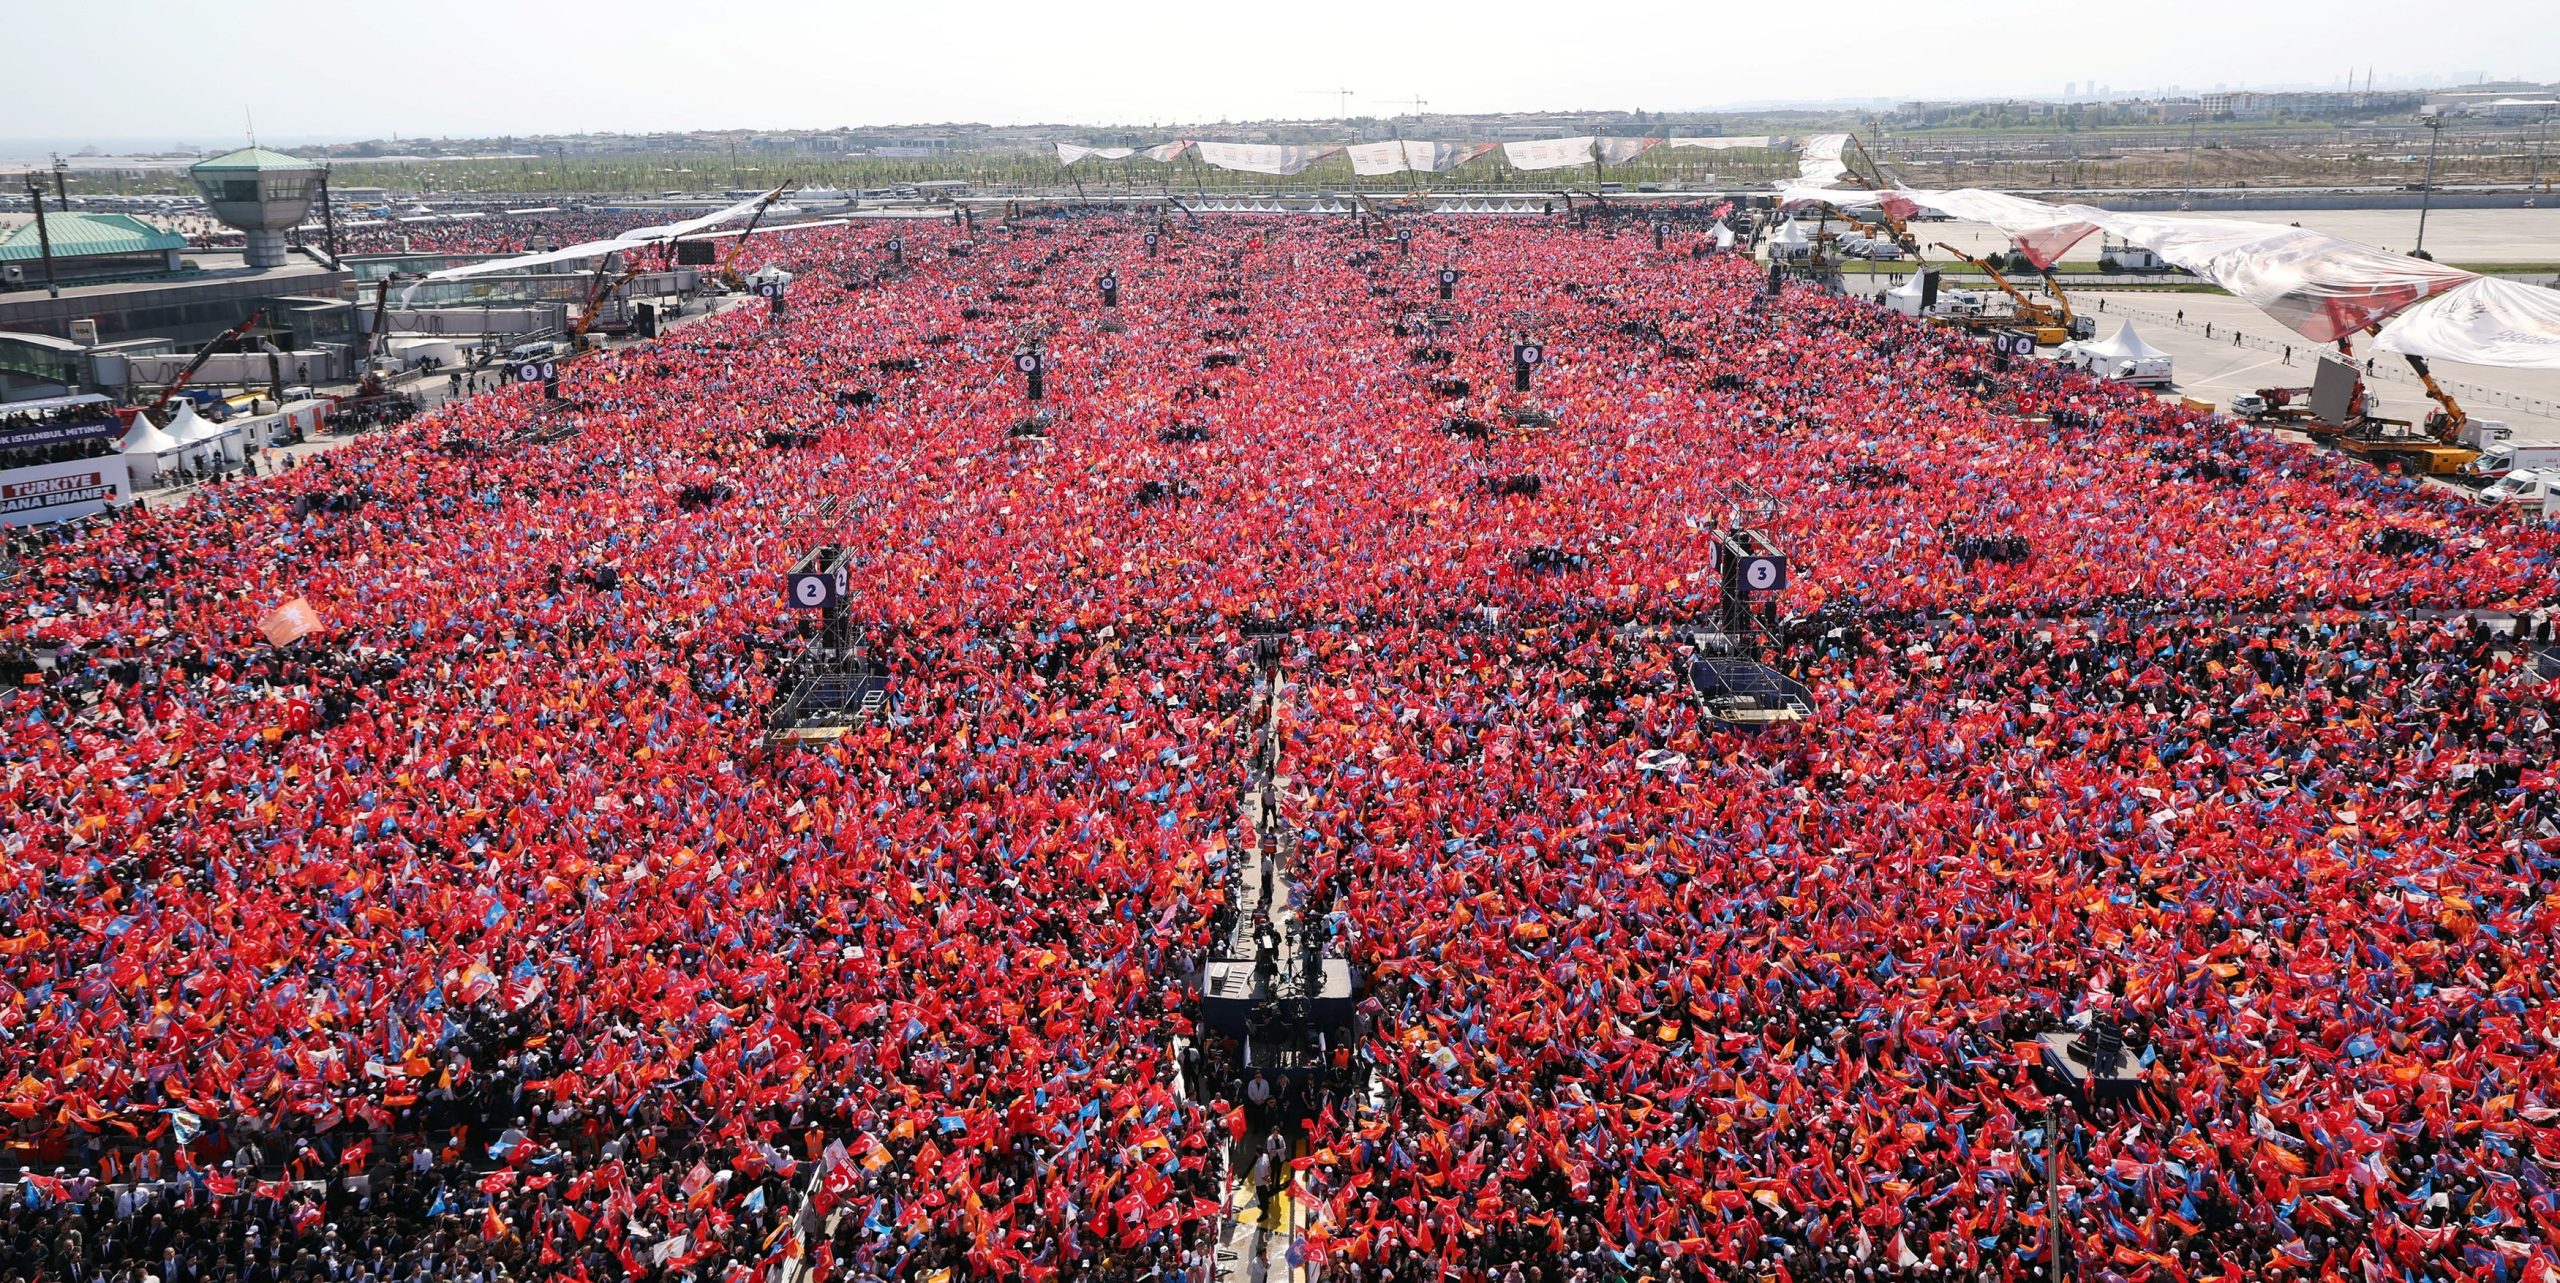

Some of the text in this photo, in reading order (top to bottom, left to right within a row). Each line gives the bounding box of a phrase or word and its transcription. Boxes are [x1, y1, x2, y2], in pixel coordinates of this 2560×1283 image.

[839, 573, 845, 588] 2
[1757, 567, 1767, 581] 3
[807, 584, 817, 598] 2
